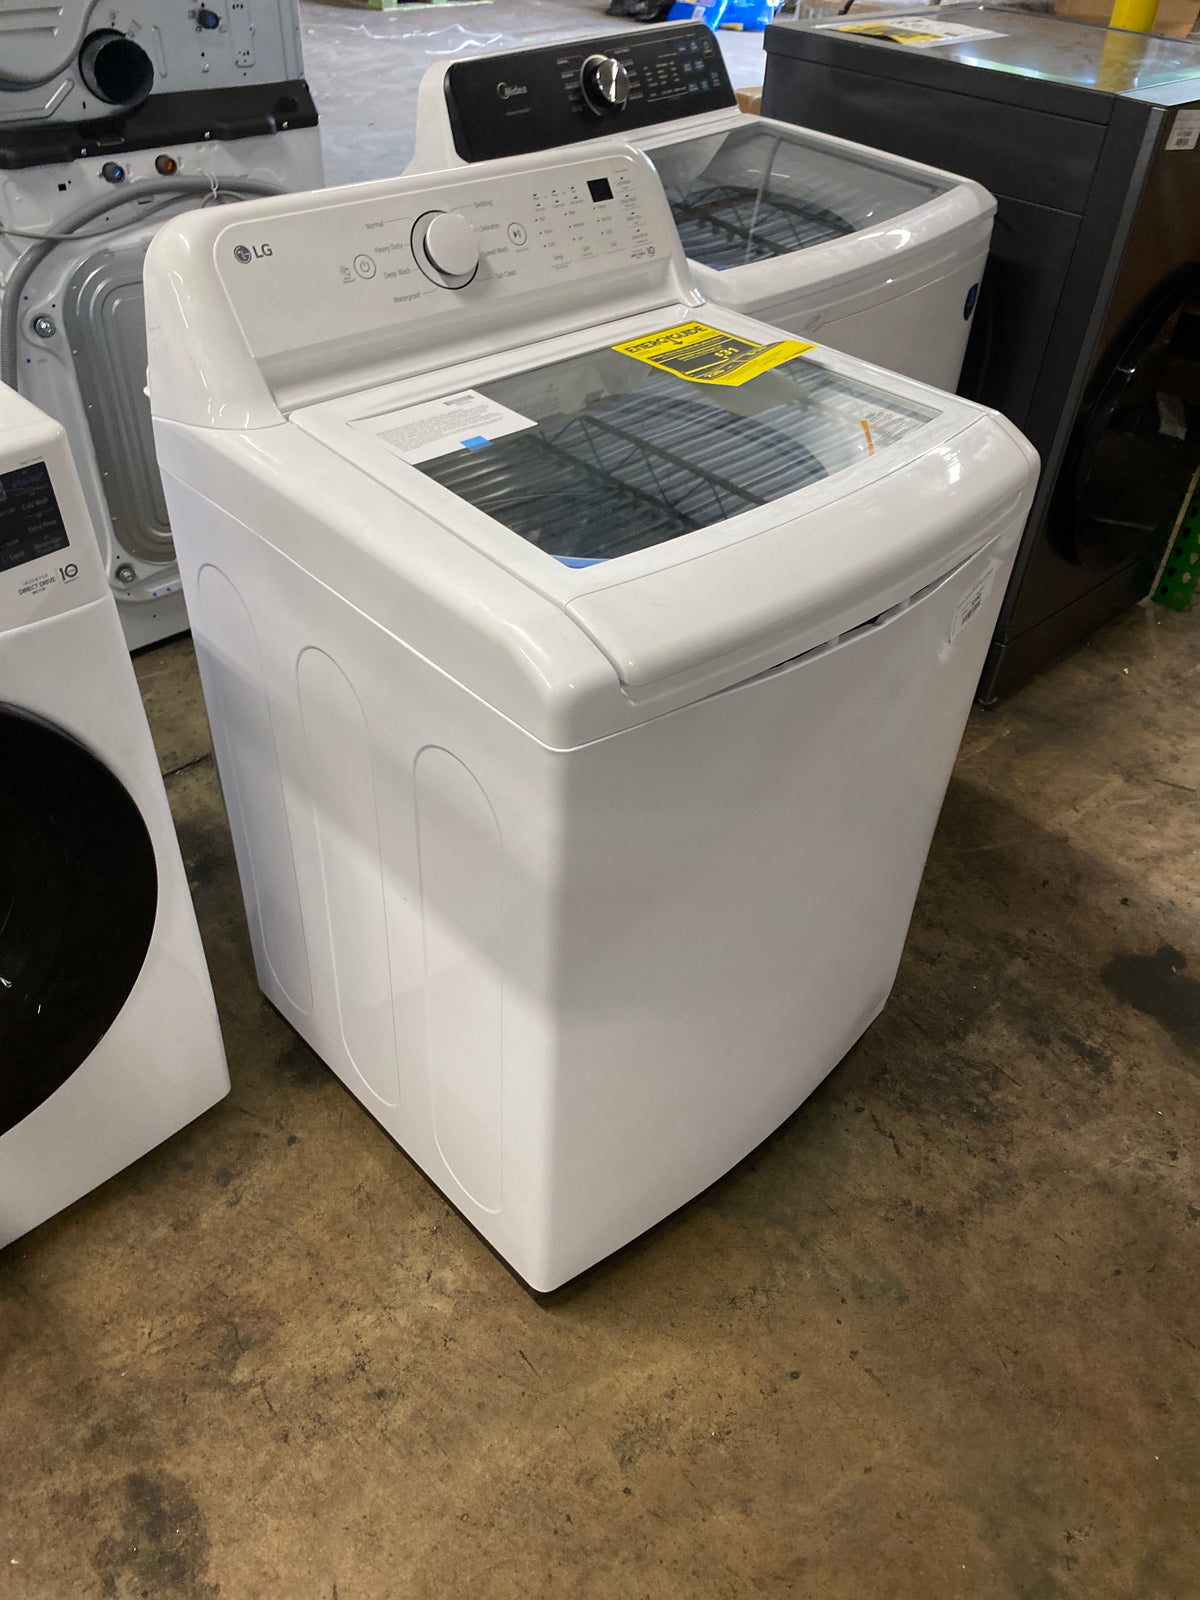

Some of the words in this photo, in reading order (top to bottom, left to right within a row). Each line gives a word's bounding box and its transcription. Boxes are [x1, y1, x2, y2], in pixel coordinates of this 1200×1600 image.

[500, 83, 528, 98] Midea
[365, 220, 384, 230] Normal
[252, 243, 273, 259] LG
[384, 271, 398, 280] Deep
[59, 563, 78, 581] 10
[18, 582, 38, 596] DIRECT
[39, 576, 56, 590] DRIVE
